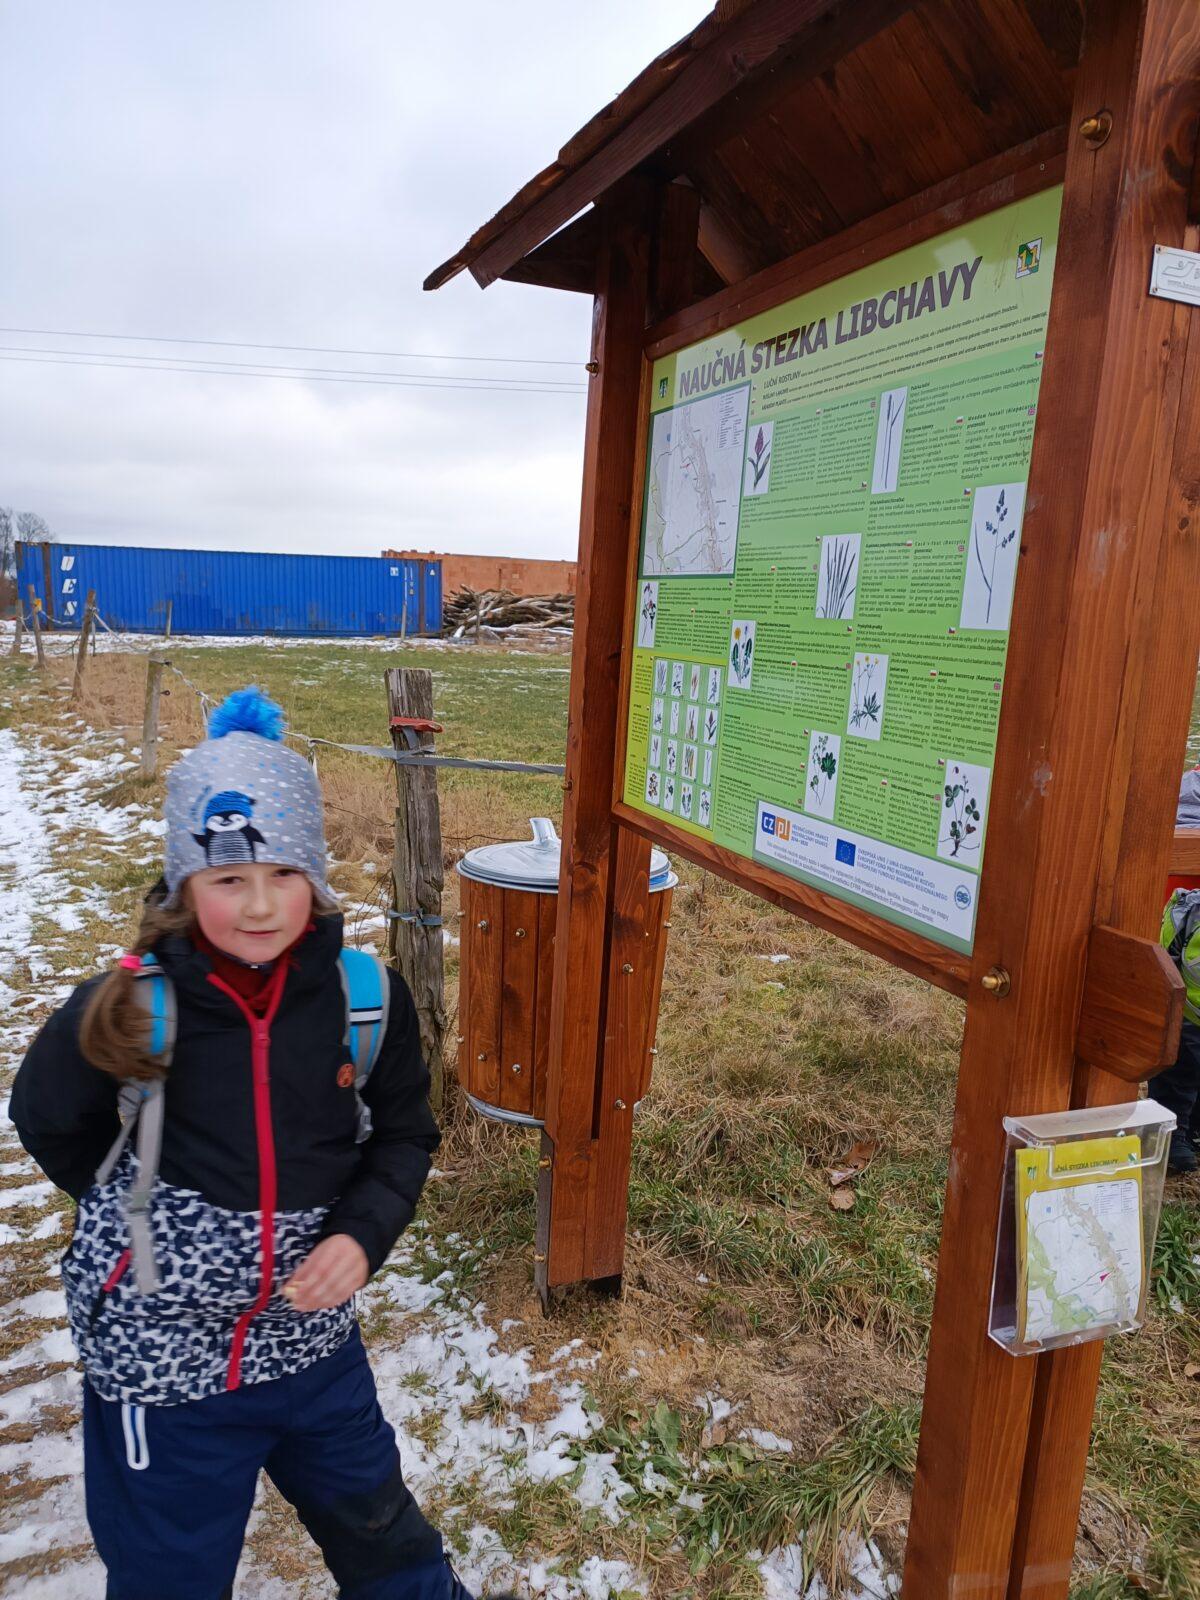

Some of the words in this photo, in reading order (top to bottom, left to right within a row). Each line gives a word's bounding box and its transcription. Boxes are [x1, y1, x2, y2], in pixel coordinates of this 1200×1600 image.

[1018, 246, 1038, 272] 11
[679, 339, 748, 400] NAUČNÁ
[750, 317, 828, 374] STEZKA
[834, 256, 983, 345] LIBCHAVY
[779, 371, 801, 383] ROSTLINY
[764, 817, 774, 830] CZ
